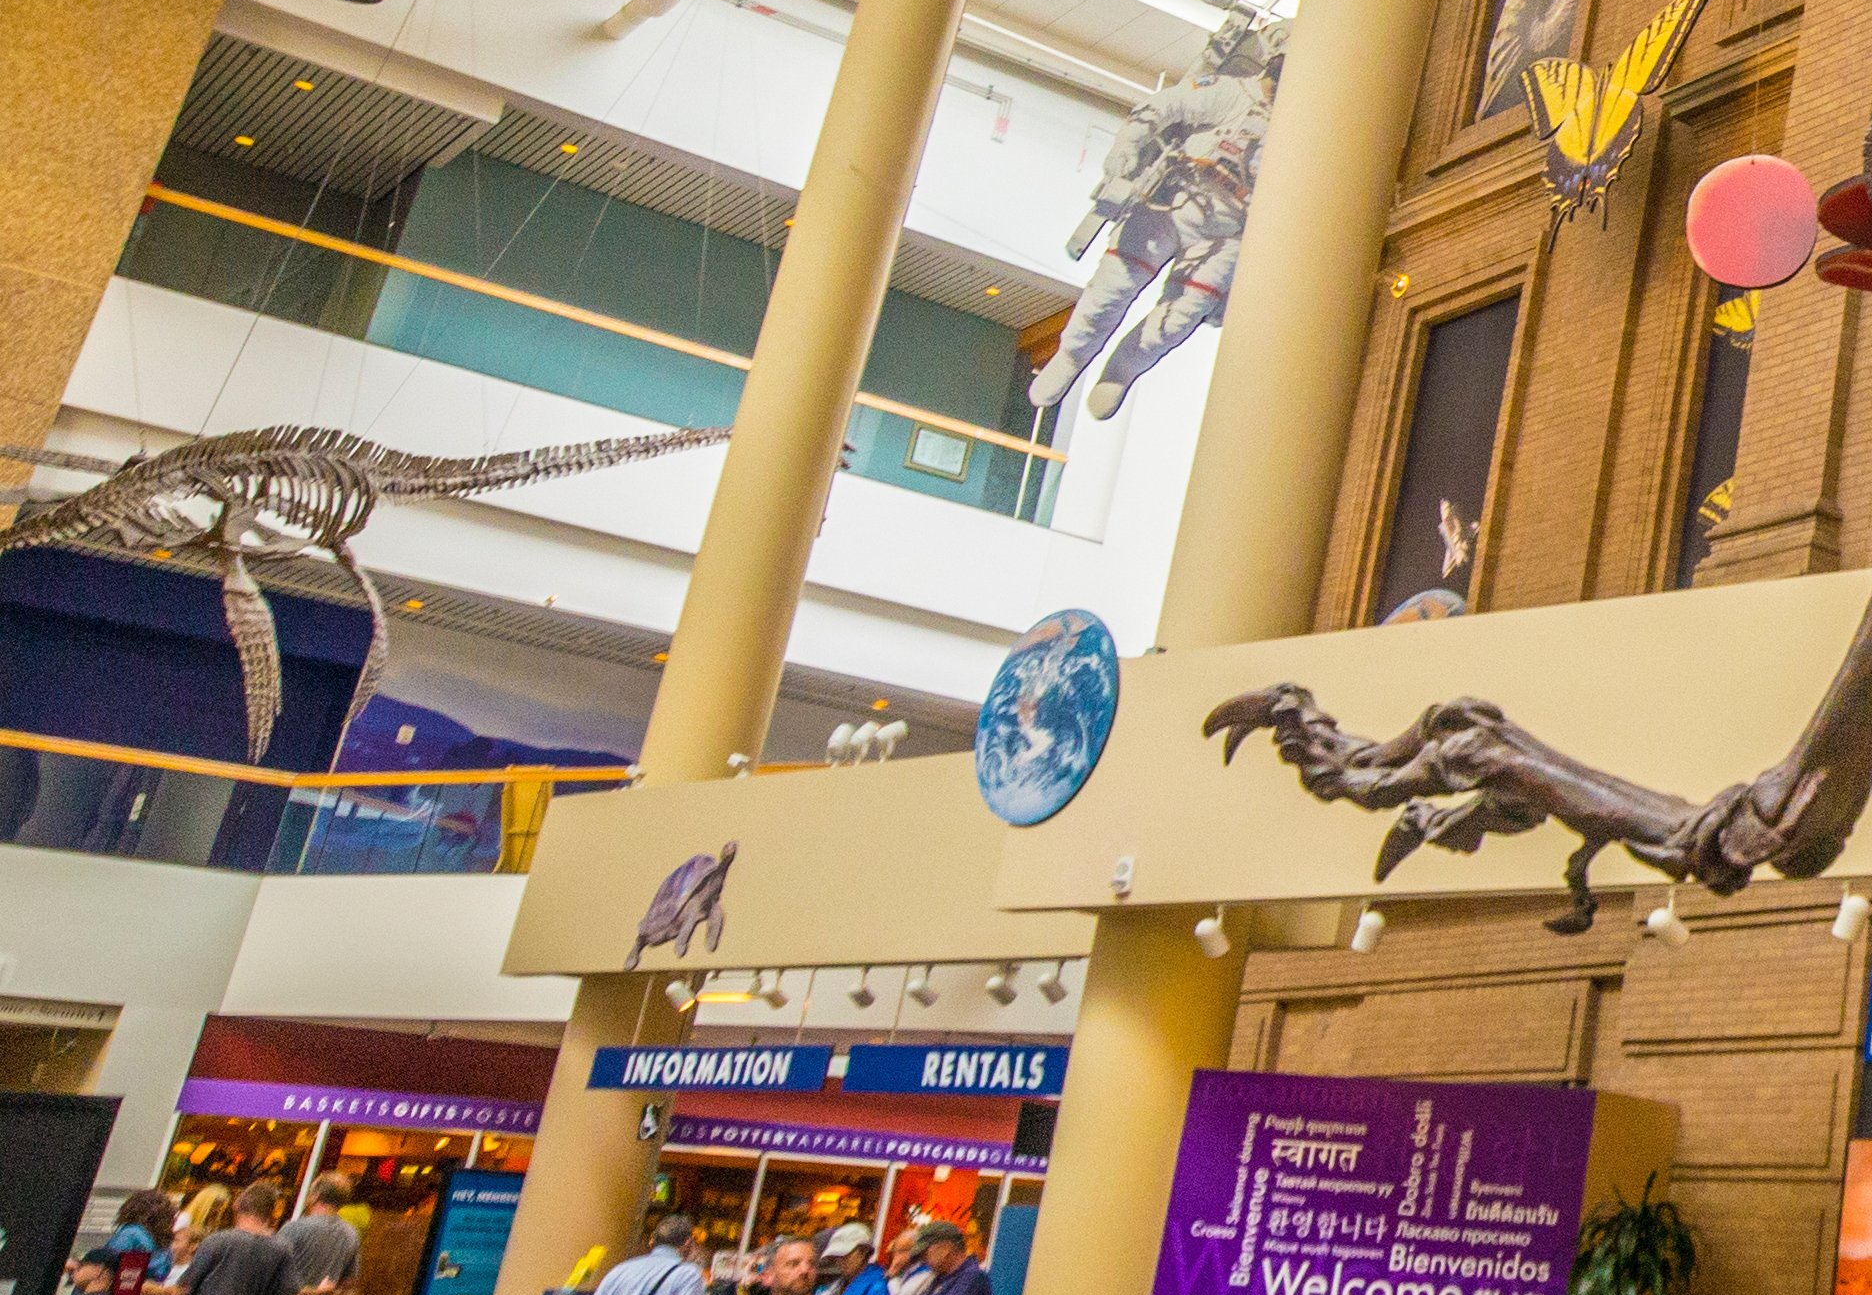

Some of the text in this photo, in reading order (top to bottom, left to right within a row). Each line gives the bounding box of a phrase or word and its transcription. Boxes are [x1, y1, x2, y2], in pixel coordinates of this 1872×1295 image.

[623, 1051, 793, 1086] INFORMATION
[921, 1052, 1047, 1089] RENTALS
[1230, 1168, 1269, 1286] Bienvenue
[1388, 1244, 1550, 1282] Bienvenidos
